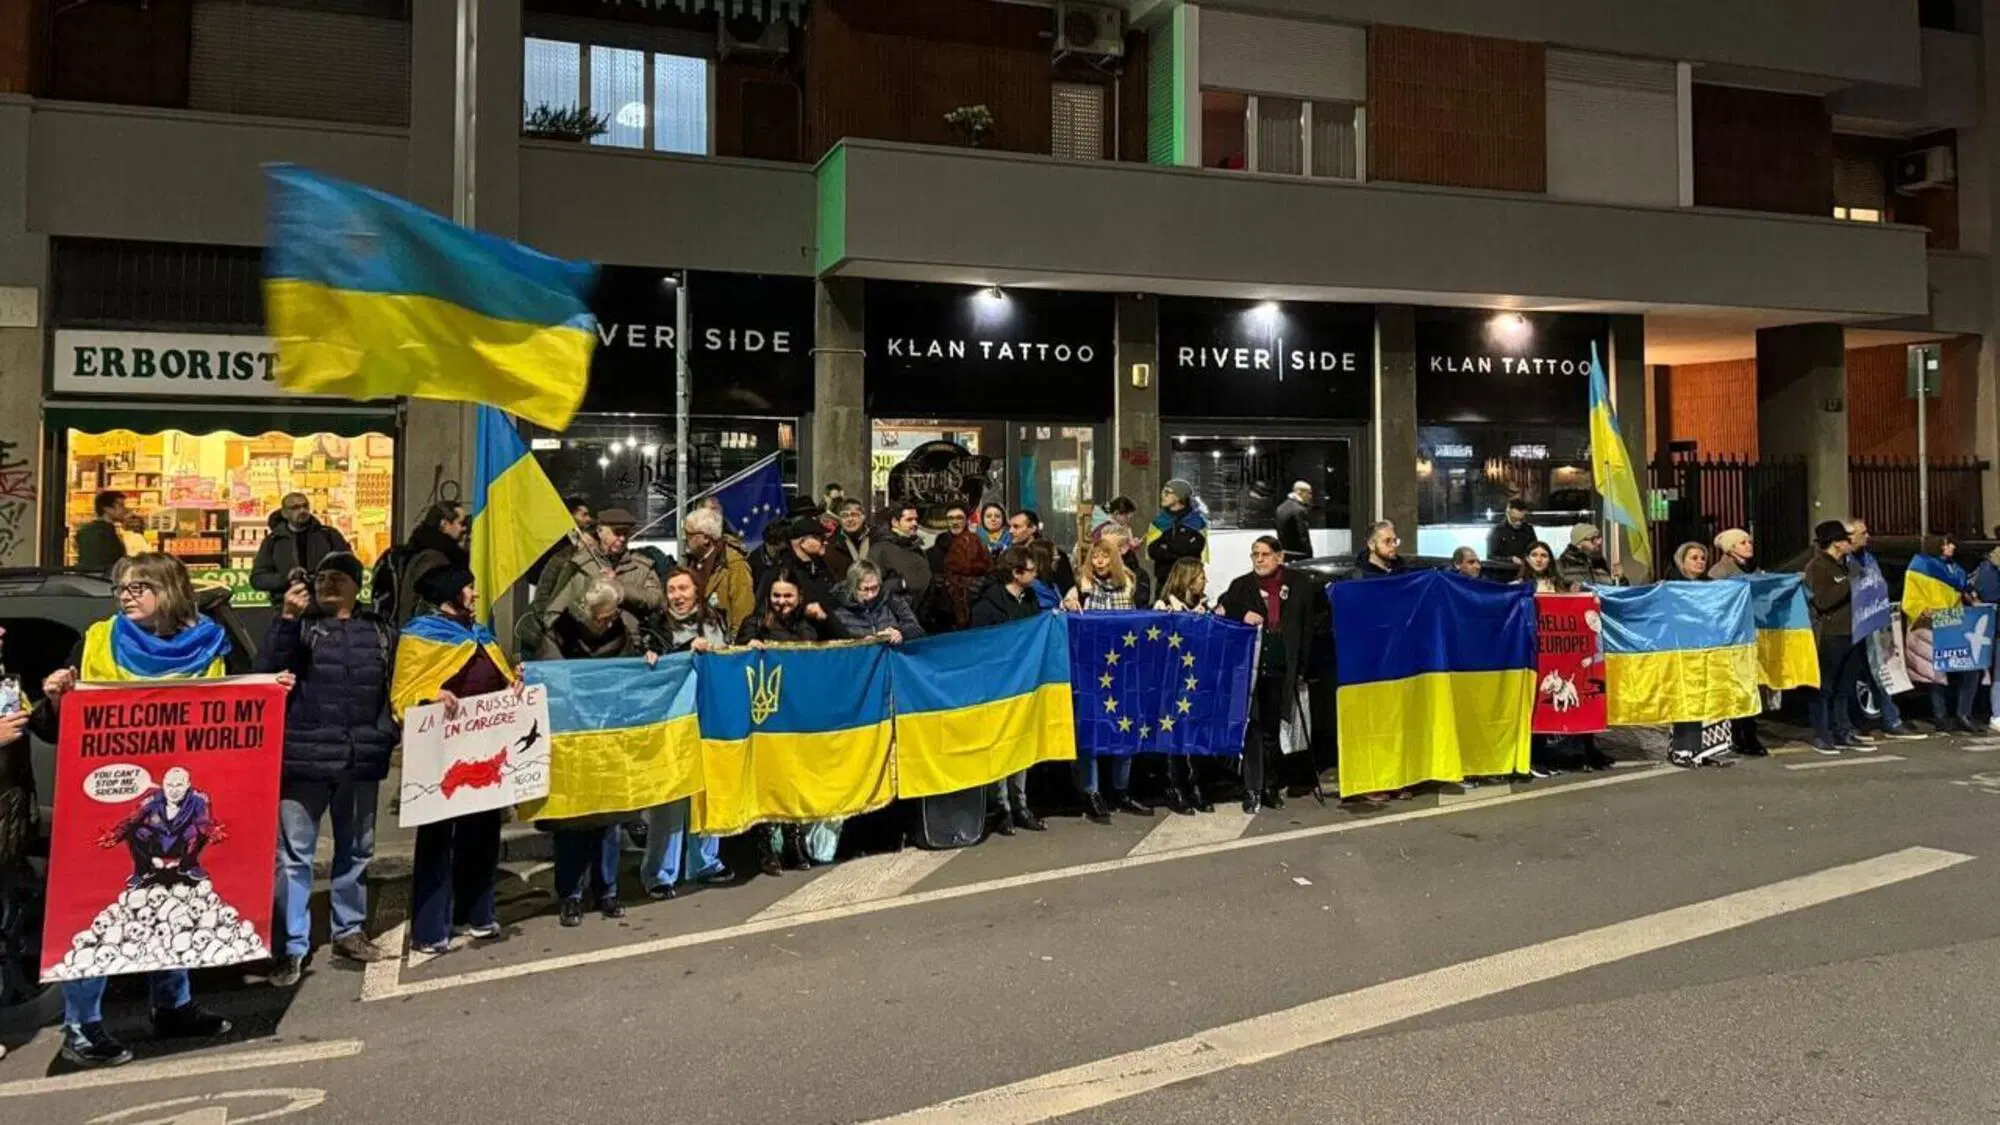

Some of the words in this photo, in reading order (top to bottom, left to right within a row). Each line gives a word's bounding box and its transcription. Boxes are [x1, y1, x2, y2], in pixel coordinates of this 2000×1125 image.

[705, 328, 790, 352] SIDE
[888, 338, 965, 359] KLAN
[979, 341, 1094, 362] TATTOO
[1178, 347, 1270, 370] RIVER
[1291, 350, 1356, 371] SIDE
[1430, 355, 1491, 373] KLAN
[1502, 357, 1592, 376] TATTOO
[1539, 614, 1576, 632] HELLO
[1540, 635, 1589, 653] EUROPE!
[83, 702, 191, 729] WELCOME
[200, 699, 226, 724] TO
[233, 698, 266, 723] MY
[418, 713, 434, 733] LA
[444, 723, 460, 739] IN
[464, 711, 516, 732] CARCERE
[80, 729, 176, 757] RUSSIAN
[185, 725, 265, 751] WORLD!
[94, 771, 112, 779] YOU
[114, 769, 140, 778] CAN'T
[96, 779, 119, 787] STOP
